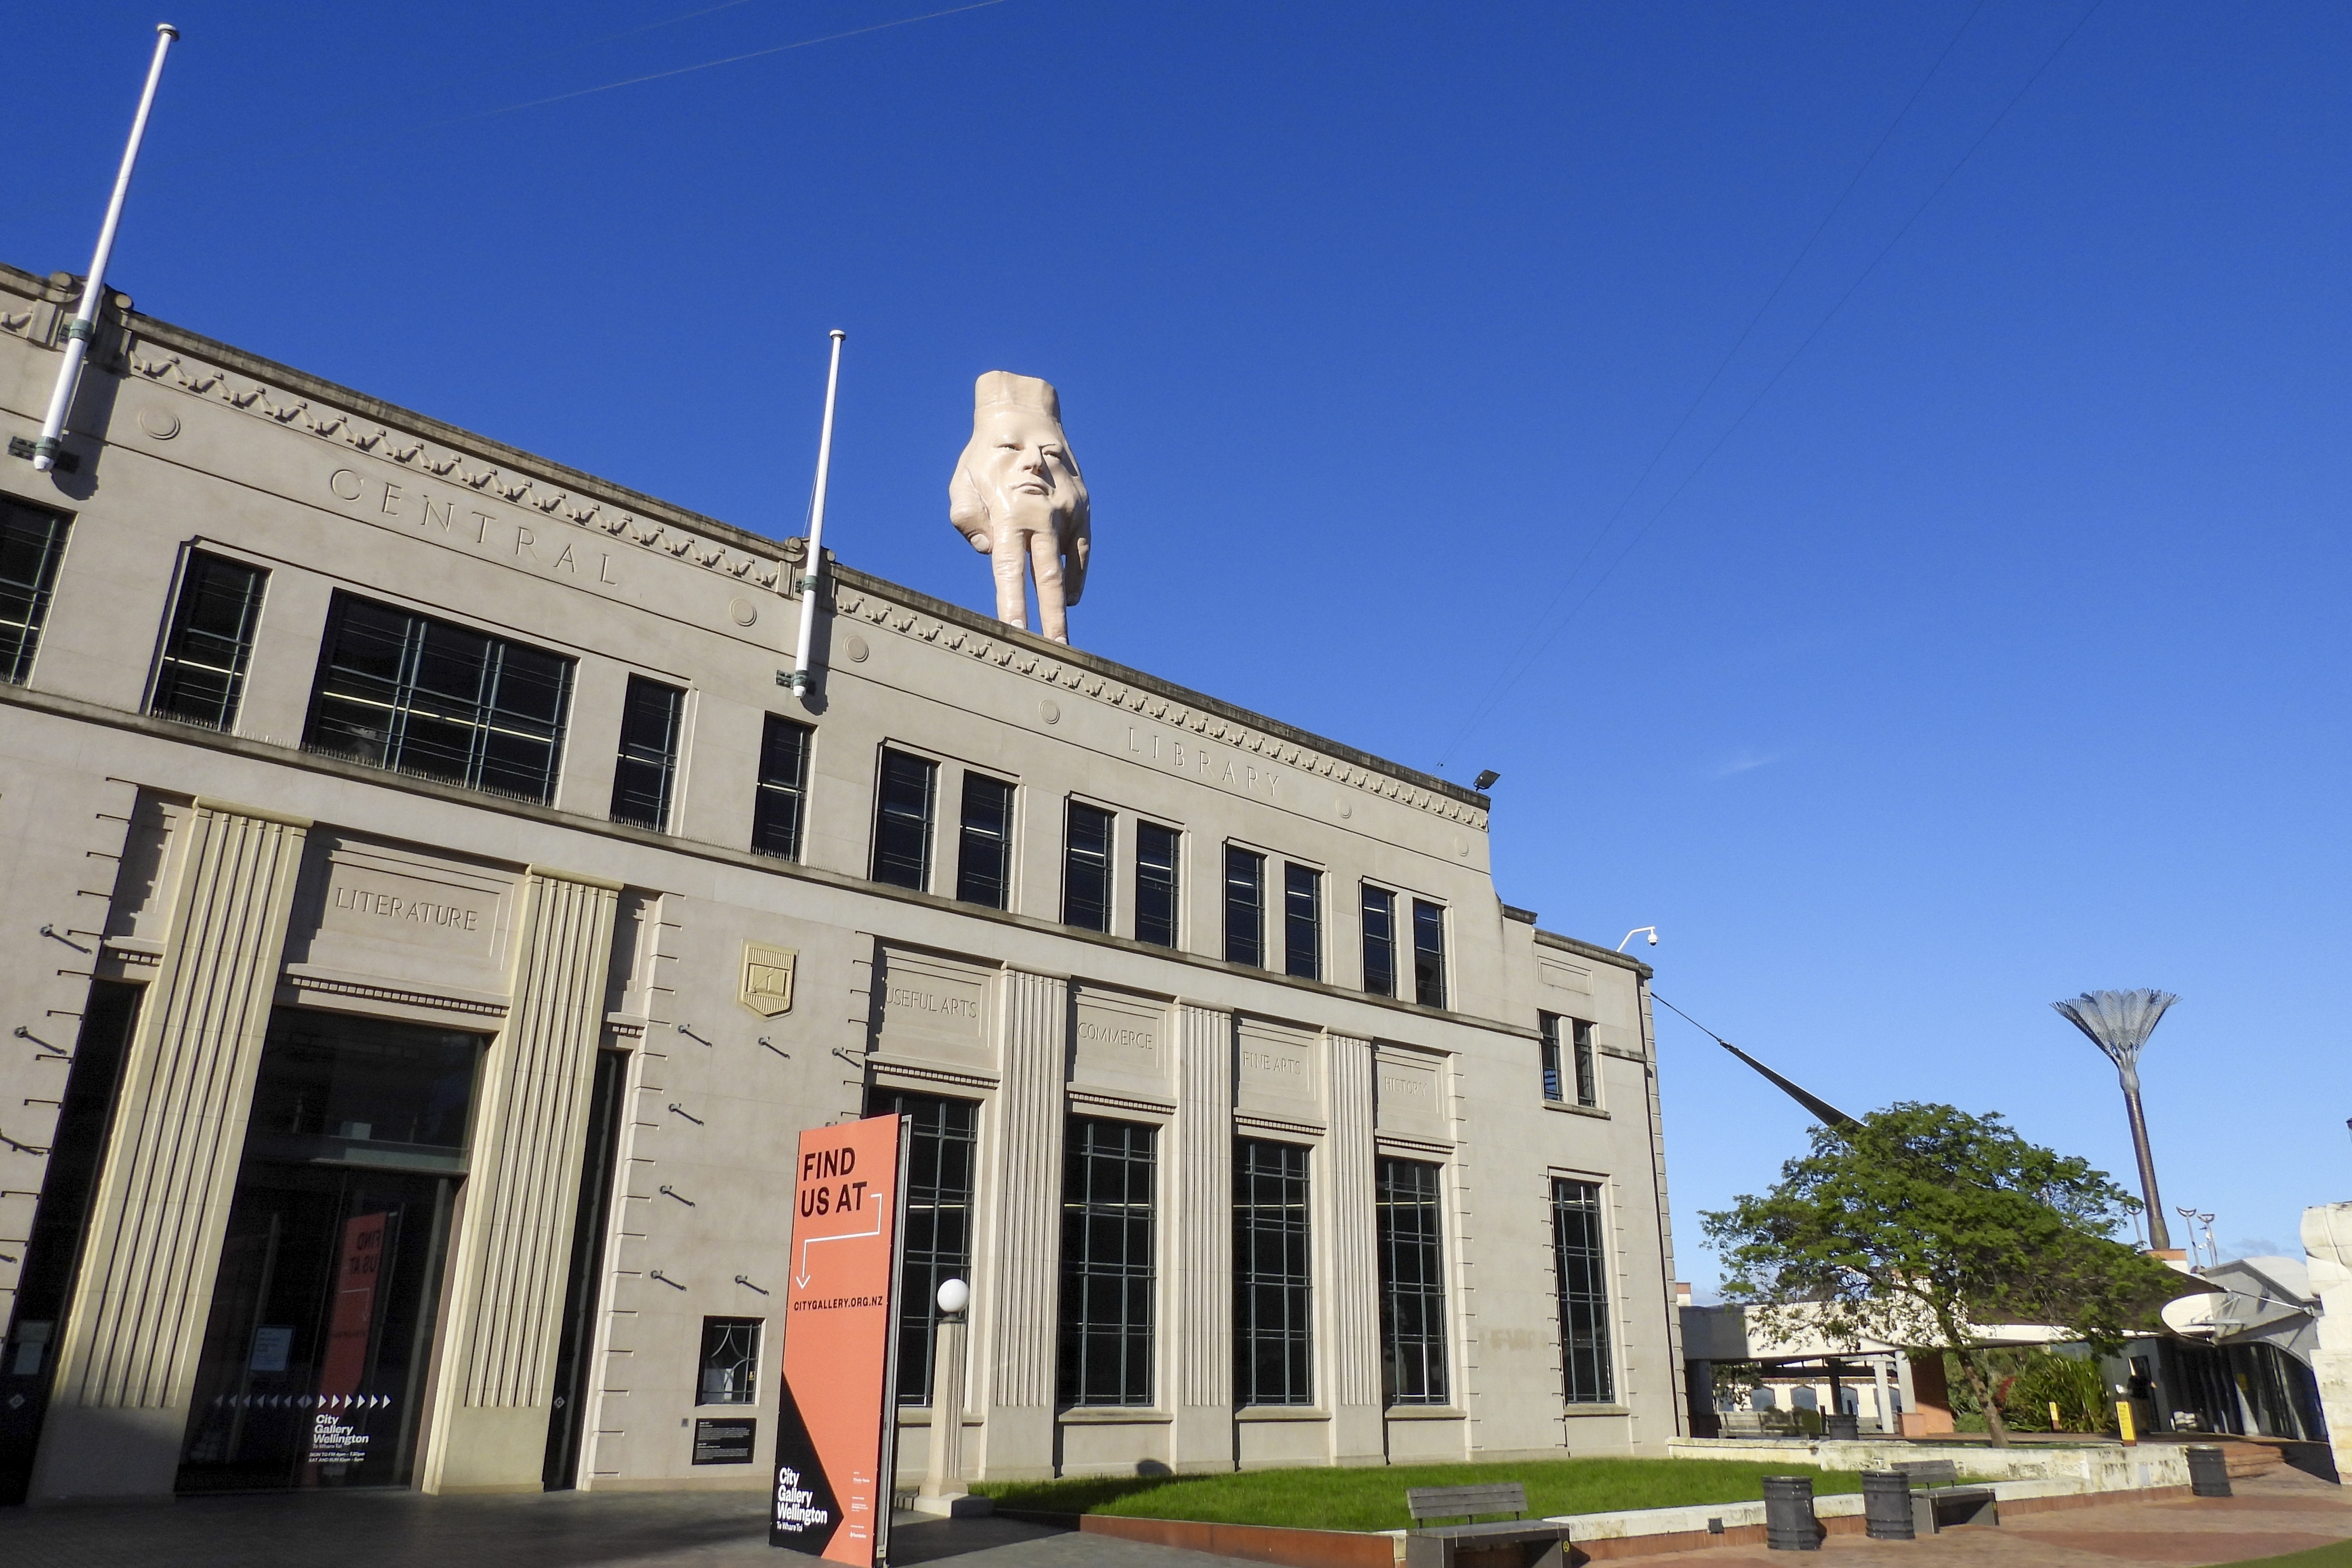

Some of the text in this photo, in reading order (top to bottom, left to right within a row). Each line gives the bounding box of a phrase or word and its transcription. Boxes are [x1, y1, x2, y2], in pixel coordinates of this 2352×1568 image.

[330, 469, 617, 586] CENTRAL
[1129, 727, 1279, 796] LIBRARY
[336, 887, 478, 931] LITERATURE
[885, 987, 977, 1018] USEFUL ARTS
[1078, 1022, 1153, 1050] COMMERCE
[1243, 1051, 1302, 1075] FINE ARTS
[1384, 1077, 1427, 1097] HISTORY
[803, 1147, 856, 1181] FIND
[801, 1181, 867, 1217] US AT
[794, 1296, 883, 1311] CITYGALLERY.ORG.NZ
[314, 1424, 354, 1436] Gallery
[316, 1413, 340, 1425] City
[313, 1433, 369, 1446] Wellington
[780, 1467, 800, 1488] City
[778, 1484, 813, 1508] Gallery
[777, 1502, 828, 1525] Wellington
